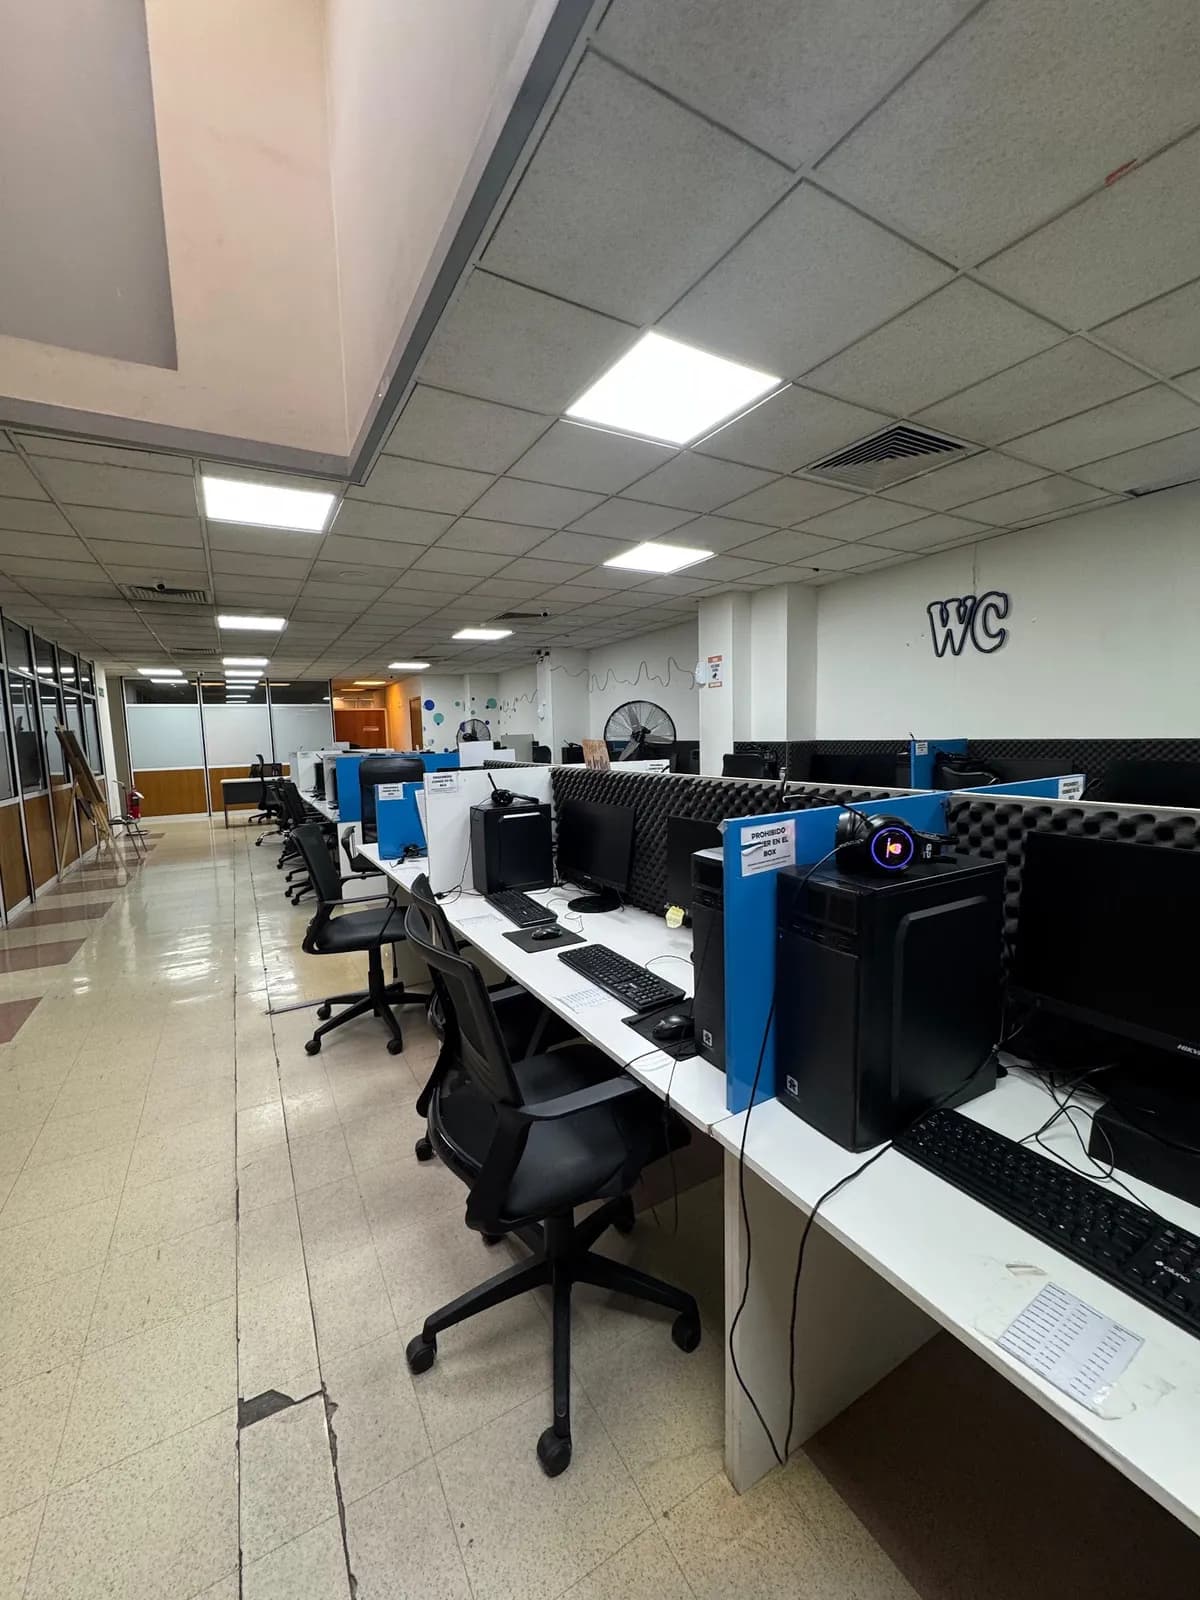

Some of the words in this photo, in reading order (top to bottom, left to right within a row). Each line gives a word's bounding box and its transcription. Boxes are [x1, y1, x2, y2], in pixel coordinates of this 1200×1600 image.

[927, 591, 1008, 657] WC
[751, 827, 785, 839] PROHIBIDO
[763, 849, 776, 857] BOX
